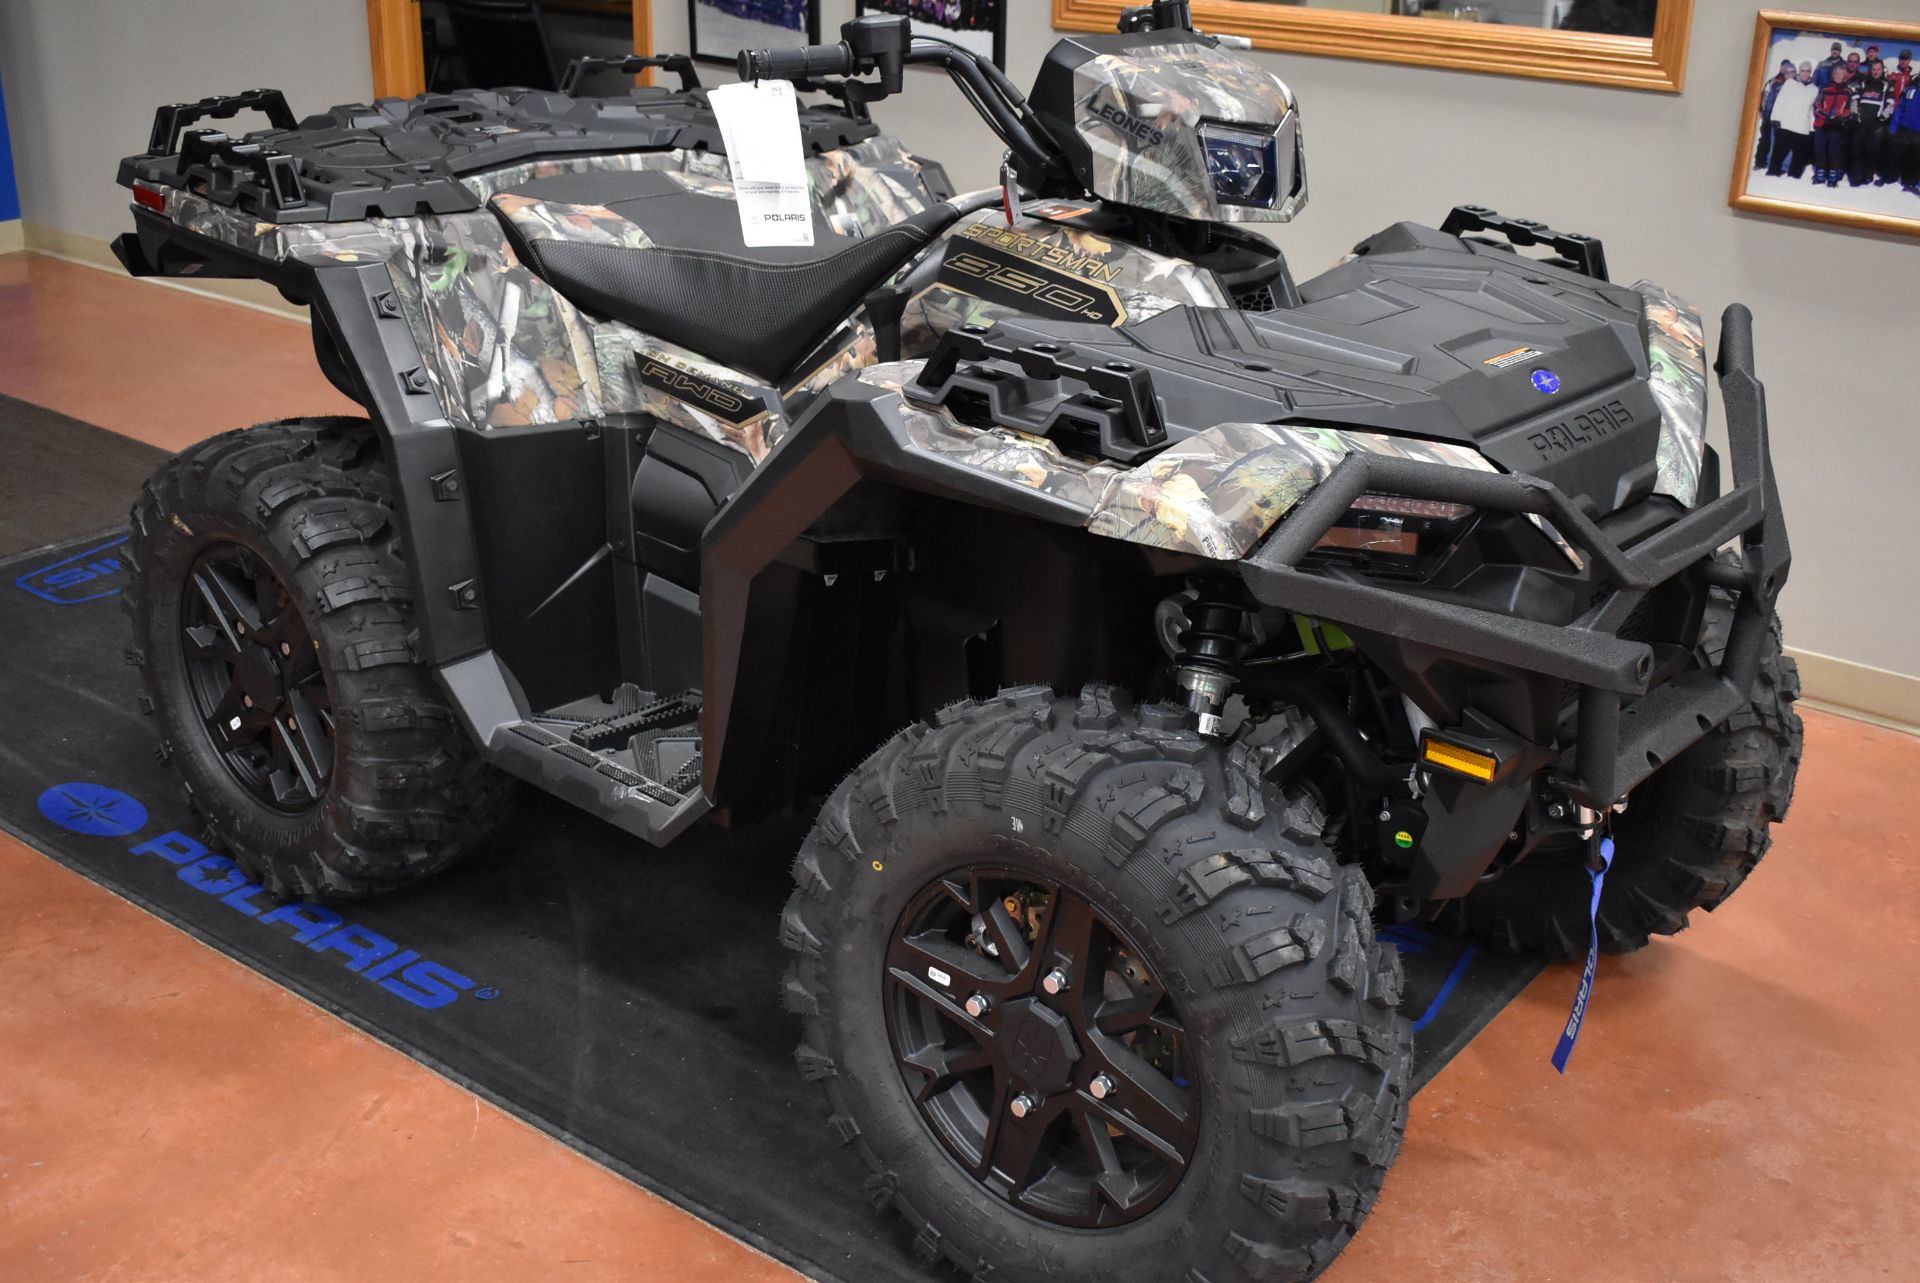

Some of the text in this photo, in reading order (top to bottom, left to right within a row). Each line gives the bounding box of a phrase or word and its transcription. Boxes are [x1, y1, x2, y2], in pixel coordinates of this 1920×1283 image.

[1086, 93, 1163, 145] LEONE'S
[764, 214, 806, 222] POLARIS
[942, 252, 1096, 312] 850
[962, 223, 1123, 282] SPORTSMAN
[642, 361, 742, 412] AWD
[674, 362, 745, 394] DEMAND
[1527, 400, 1634, 461] POLARIS
[128, 831, 477, 1009] POLARIS
[1565, 947, 1595, 1041] OLARIS
